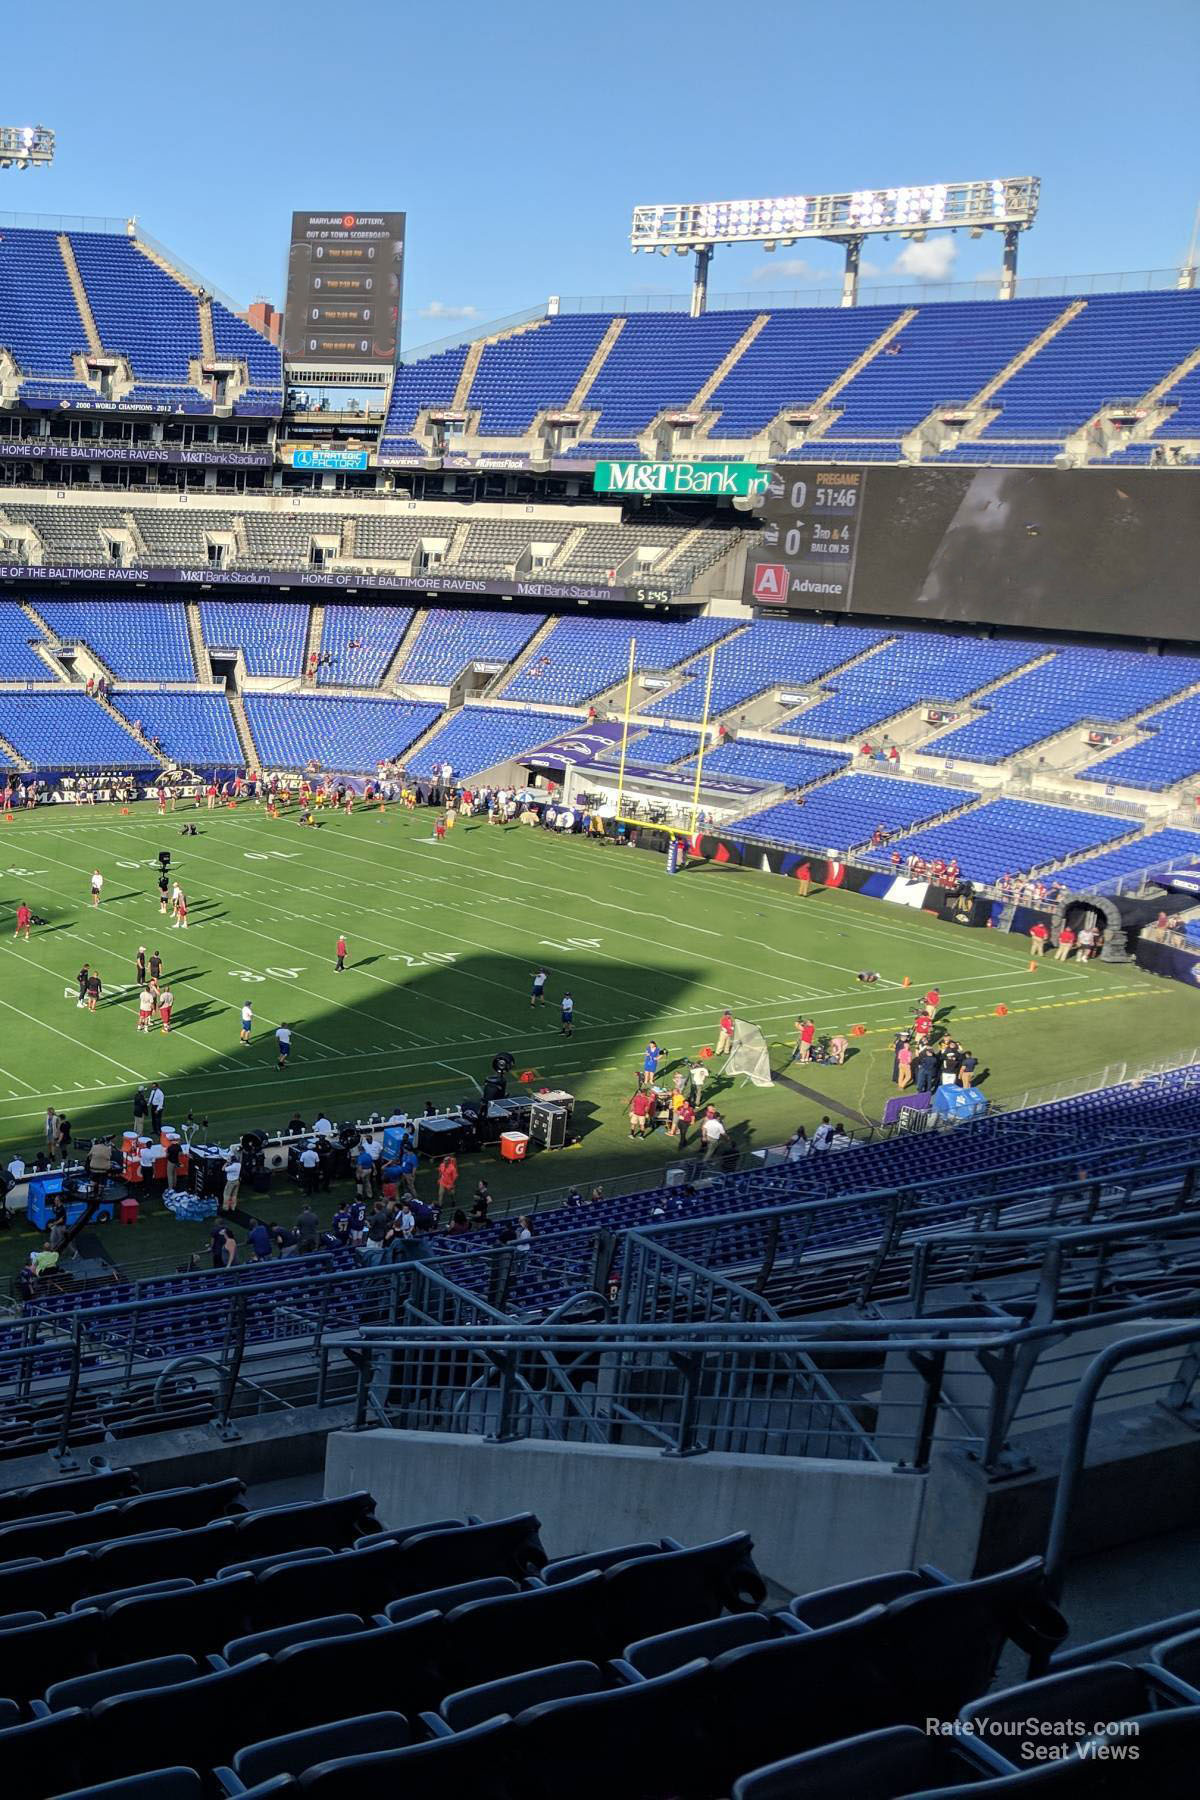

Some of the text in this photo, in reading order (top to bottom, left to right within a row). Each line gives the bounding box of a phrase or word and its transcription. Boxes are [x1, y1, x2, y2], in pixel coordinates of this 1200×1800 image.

[95, 402, 116, 410] WORLD
[118, 403, 152, 411] CHAMPIONS
[2, 446, 168, 460] HOME OF THE BALTIMORE RAVENS
[180, 452, 266, 465] M&T Bank Stadium
[312, 452, 362, 460] STRATEGIC
[312, 459, 360, 467] FACTORY
[608, 463, 673, 490] M&T
[674, 464, 738, 492] Bank
[816, 472, 860, 486] PREGAME
[791, 482, 806, 508] 0
[816, 489, 856, 506] 51:46
[813, 524, 830, 539] 3RD
[841, 526, 848, 540] 4
[785, 529, 800, 555] 0
[810, 543, 849, 554] BALL ON 25
[10, 567, 24, 577] OF
[28, 568, 46, 578] THE
[49, 568, 106, 579] BALTIMORE
[108, 570, 148, 580] RAVENS
[180, 571, 270, 584] M&T Bank Stadium
[758, 568, 778, 592] A
[302, 574, 486, 590] HOME OF THE BALTIMORE RAVENS
[792, 580, 842, 594] Advance
[518, 583, 610, 600] M&T Bank Stadium
[515, 1142, 524, 1154] G
